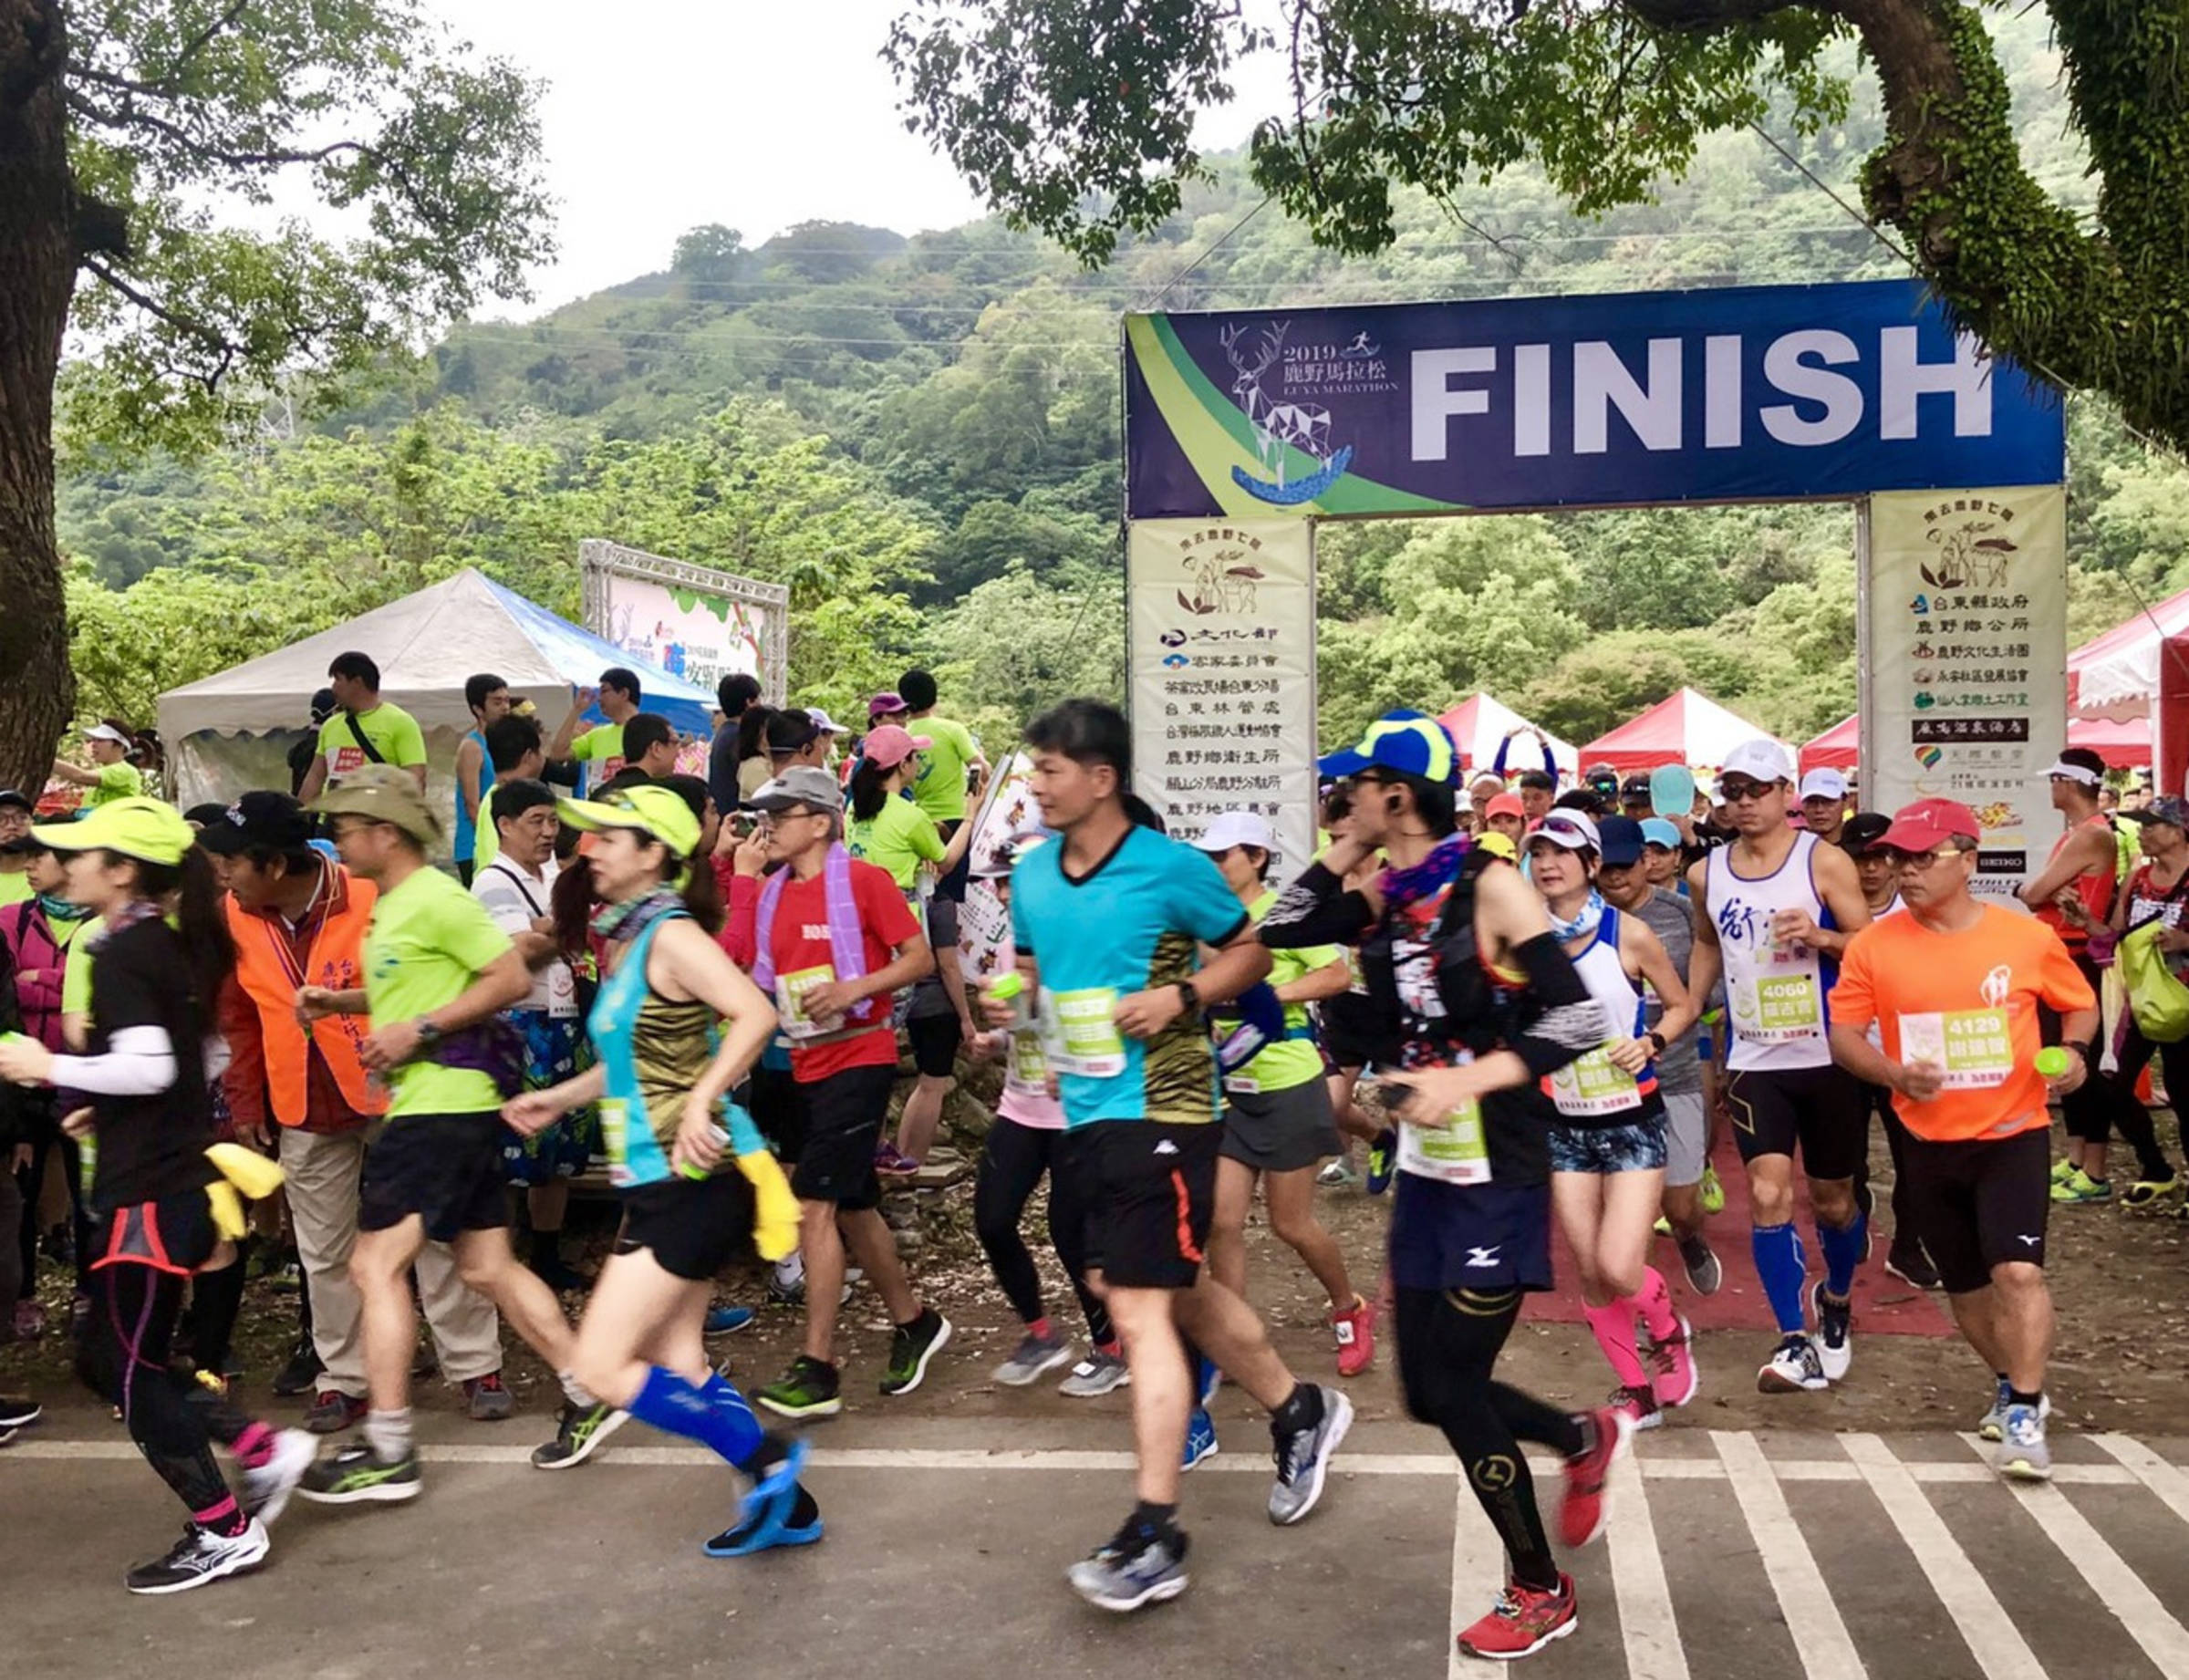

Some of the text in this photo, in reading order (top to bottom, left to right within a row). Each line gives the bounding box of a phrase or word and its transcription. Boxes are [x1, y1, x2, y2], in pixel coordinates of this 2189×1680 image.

[1283, 346, 1336, 362] 2019
[1284, 360, 1386, 383] 鹿野馬拉松
[1323, 382, 1399, 394] MARATHON
[1410, 326, 1992, 461] FINISH
[1934, 595, 2028, 611] 台東縣政府
[1916, 617, 2028, 634] 鹿野鄉公所
[1190, 627, 1279, 641] 文化部
[1192, 655, 1279, 669] 客家委員會
[1166, 749, 1280, 765] 鹿野鄉衛生所
[1979, 856, 2023, 867] SEIKO
[1763, 981, 1808, 998] 4060
[1948, 1017, 2001, 1034] 4129
